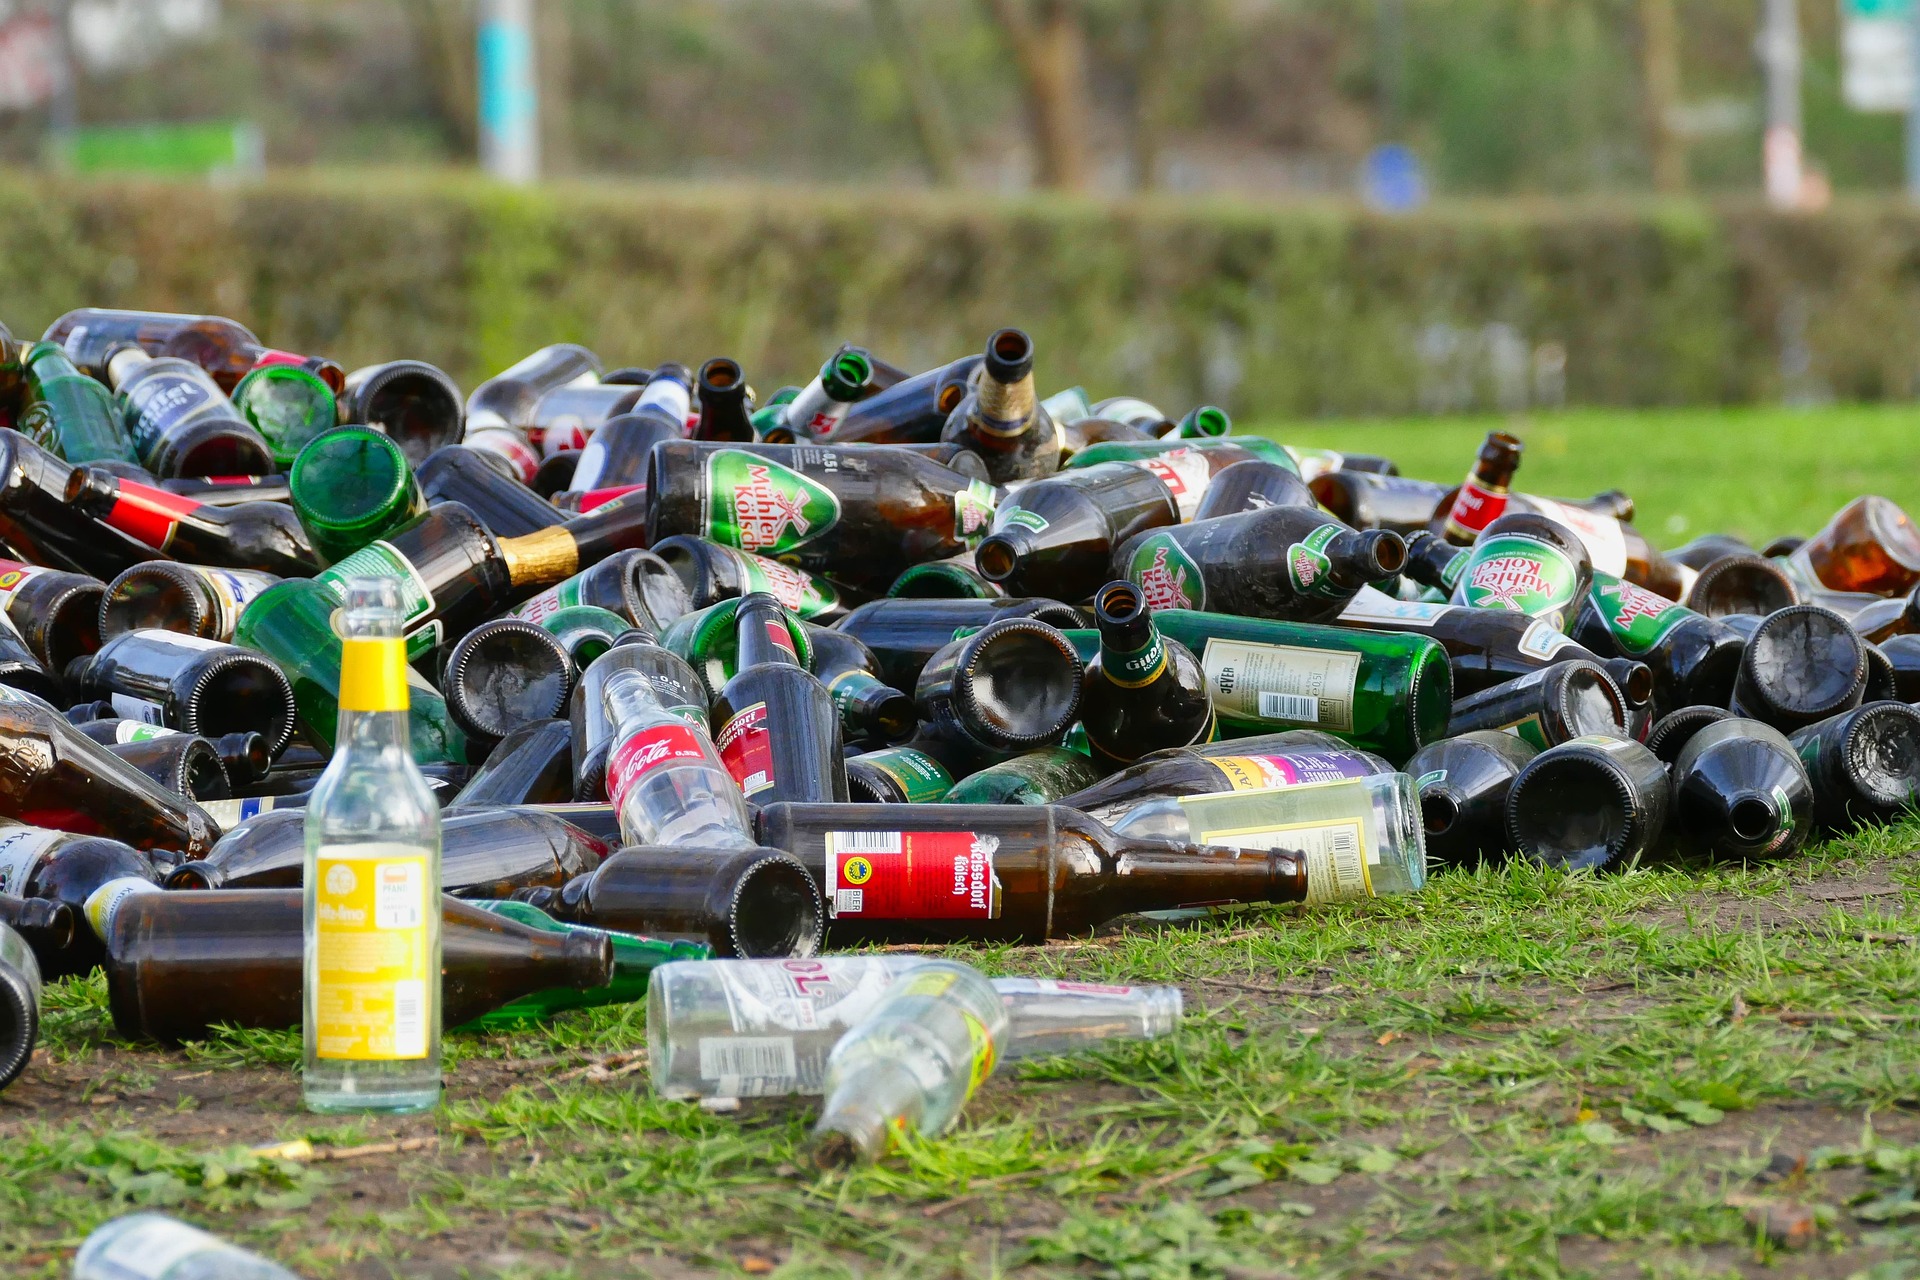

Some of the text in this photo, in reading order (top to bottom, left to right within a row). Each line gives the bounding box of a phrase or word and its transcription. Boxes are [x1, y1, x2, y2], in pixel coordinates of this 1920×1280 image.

[734, 486, 761, 553] Kölsch
[748, 464, 779, 548] Mühlen
[1313, 525, 1334, 547] FRISCH
[1294, 559, 1309, 587] Kölsch
[1299, 550, 1314, 584] Mühlen
[1471, 557, 1541, 577] Kölsch
[1472, 571, 1557, 599] Mühlen
[1219, 666, 1234, 695] JEVER
[1311, 672, 1322, 687] 0,5l
[1320, 700, 1329, 722] BIER
[675, 750, 701, 758] 0,33L
[909, 753, 942, 779] Gilden
[1216, 757, 1253, 788] ANER
[952, 855, 968, 895] Kölsch
[970, 842, 988, 909] Reissdorf
[852, 890, 861, 911] BIER
